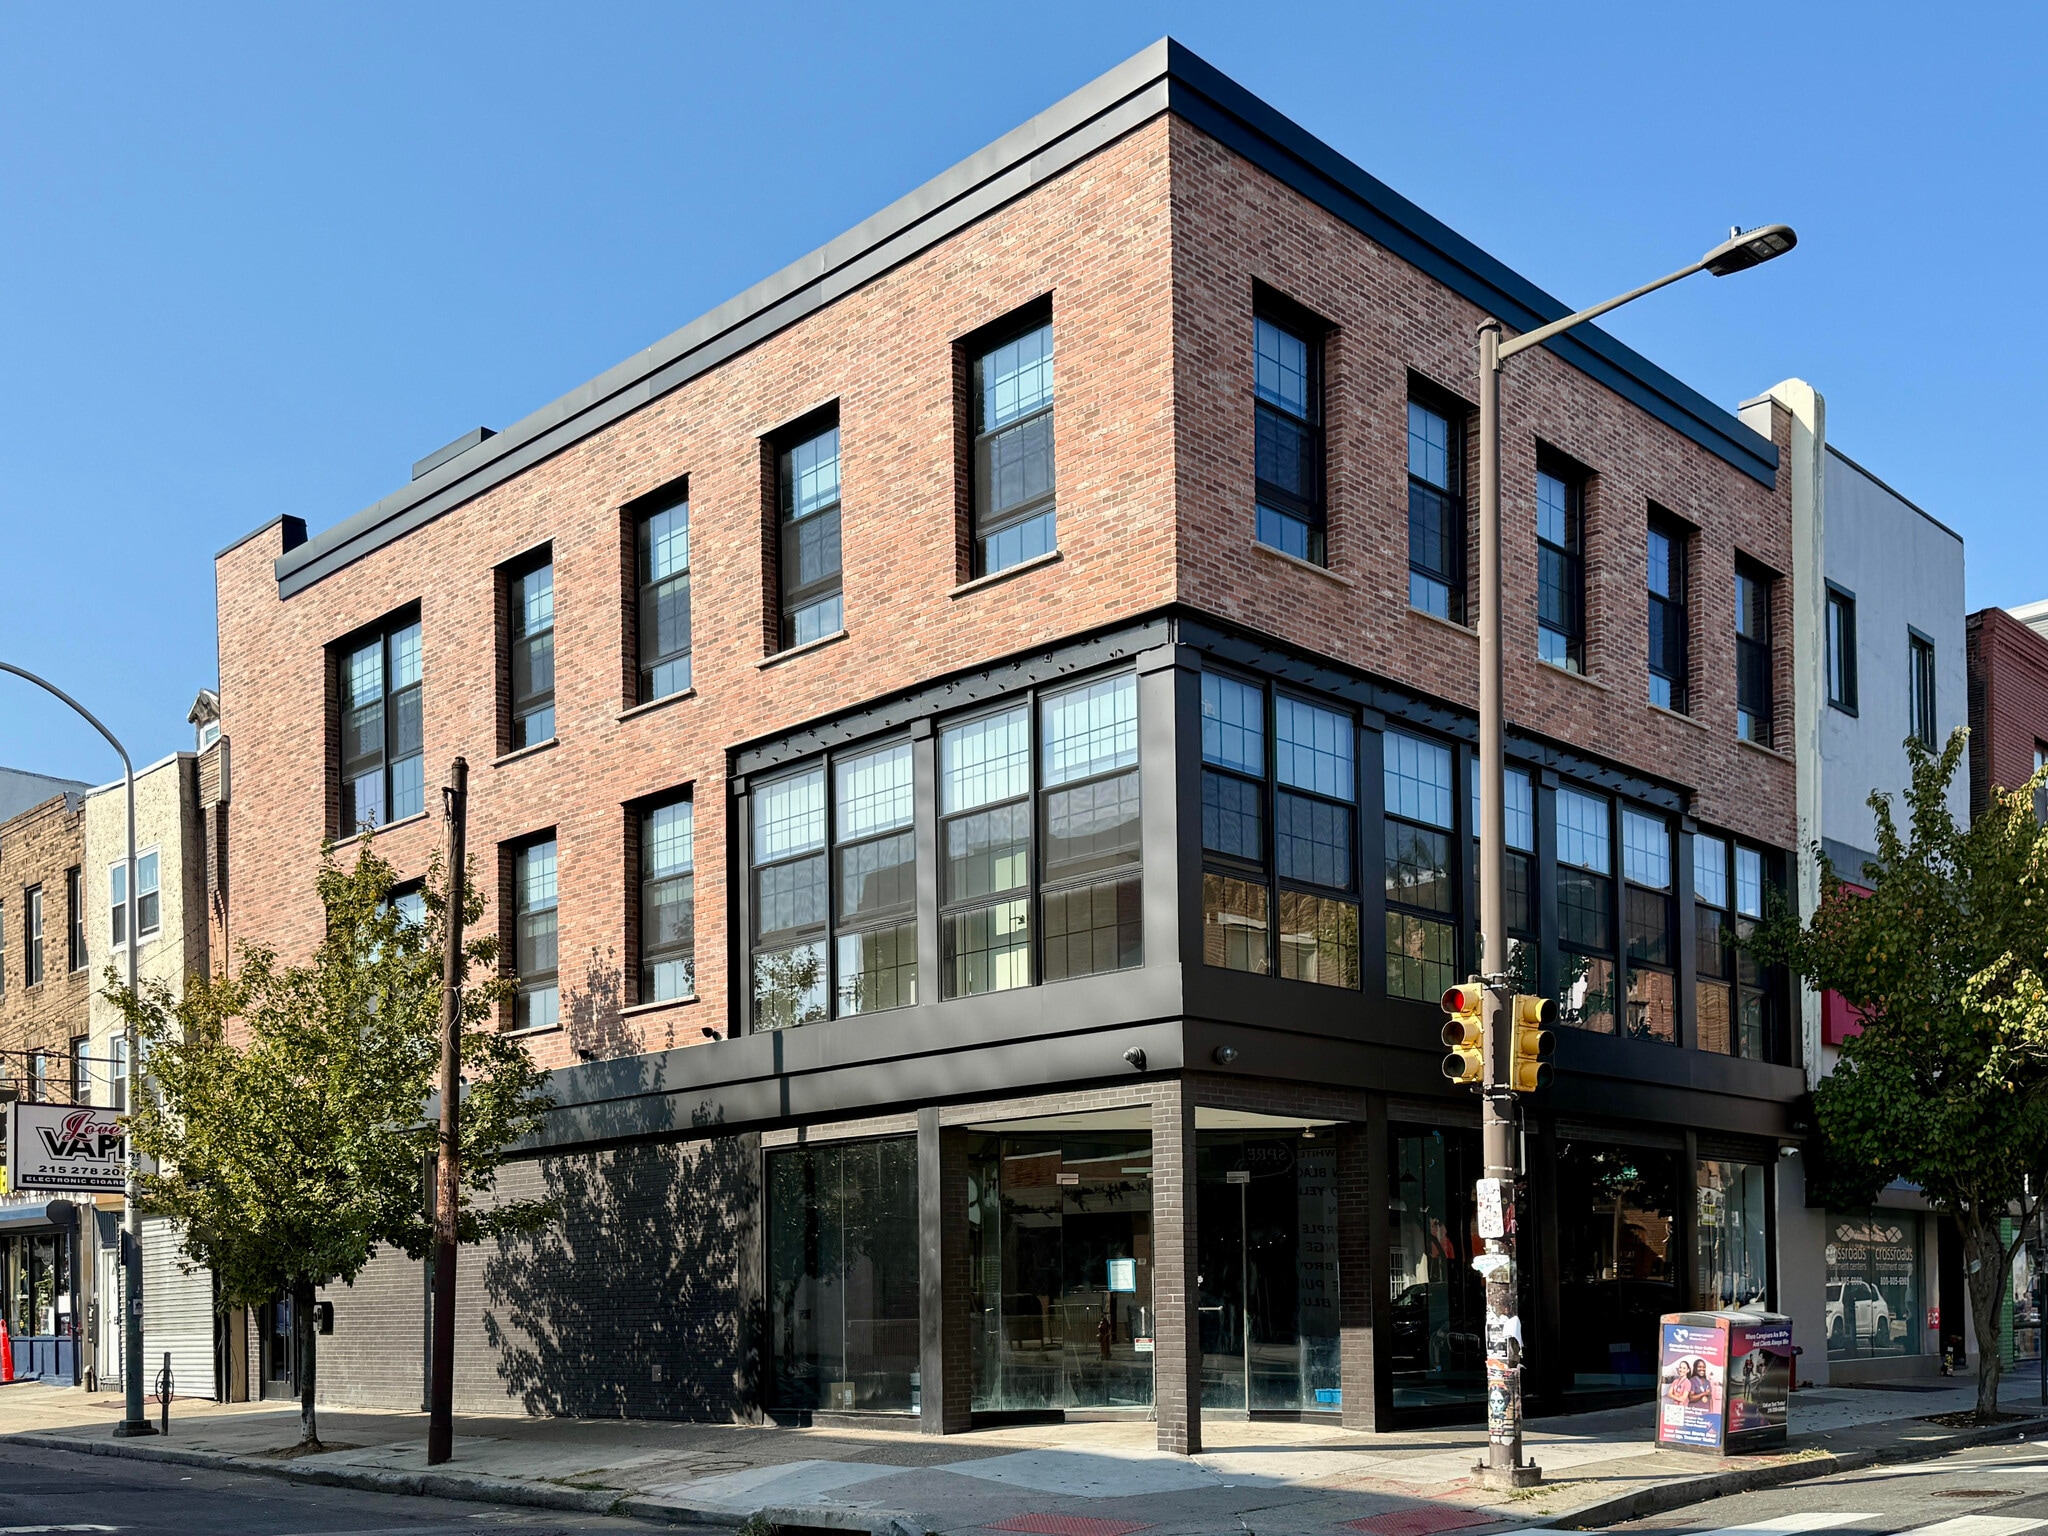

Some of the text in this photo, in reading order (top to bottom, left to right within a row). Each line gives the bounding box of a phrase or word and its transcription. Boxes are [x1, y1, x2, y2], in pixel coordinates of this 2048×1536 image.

[39, 1165, 67, 1174] 215
[71, 1166, 98, 1175] 278
[26, 1176, 125, 1186] ELECTRONIC CIGARE
[1875, 1247, 1914, 1261] crossroads
